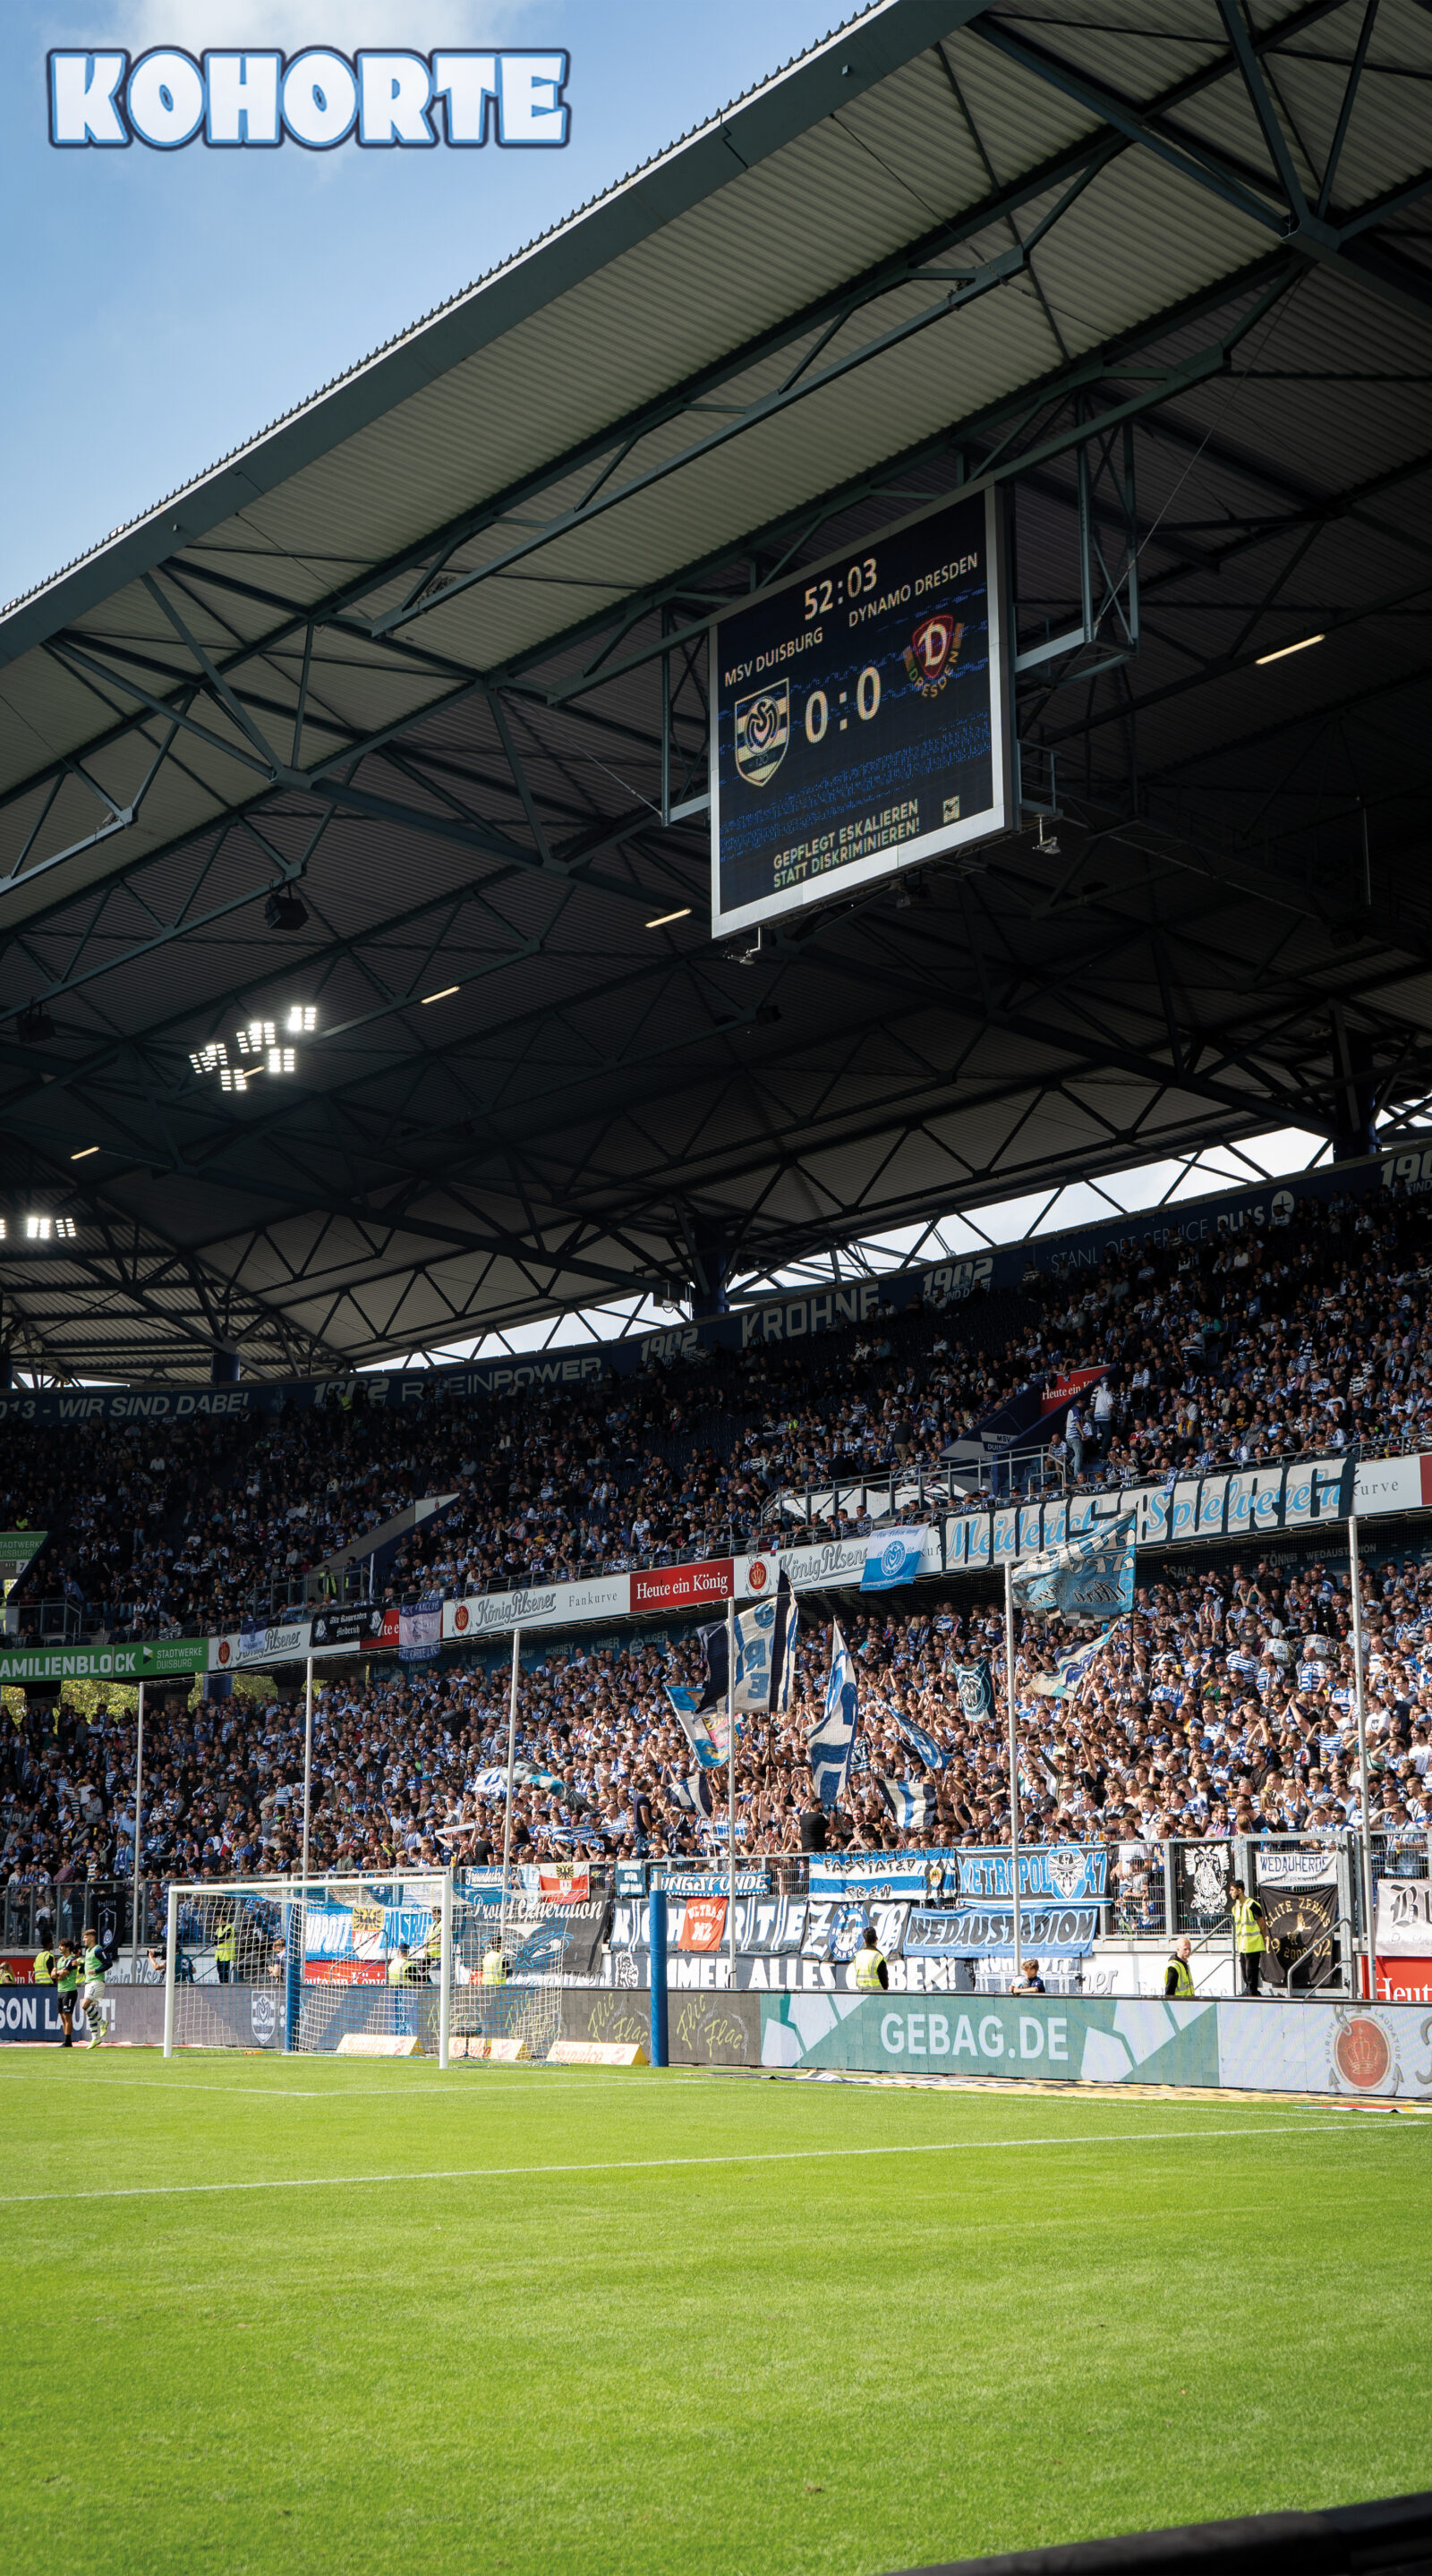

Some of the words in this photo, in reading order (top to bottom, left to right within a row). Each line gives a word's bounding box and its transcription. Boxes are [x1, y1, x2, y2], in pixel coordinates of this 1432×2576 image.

[805, 557, 877, 621] 52:03
[848, 584, 911, 627] DYNAMO
[915, 552, 978, 596] DRESDEN
[724, 660, 753, 687] MSV
[756, 626, 823, 673] DUISBURG
[773, 832, 834, 871] GEPFLEGT
[839, 798, 918, 845] ESKALIEREN
[773, 862, 807, 888] STATT
[811, 818, 920, 874] DISKRIMINIEREN!
[742, 1283, 879, 1348] KROHNE
[402, 1356, 602, 1402] REINPOWER
[1042, 1388, 1068, 1400] Heute
[58, 1398, 105, 1418] WIR
[109, 1396, 170, 1416] SIND
[946, 1501, 1103, 1559] Meiderich
[821, 1543, 868, 1575] Pilsen
[1305, 1543, 1377, 1561] WEDAUSTDION
[636, 1581, 670, 1600] Heute
[672, 1579, 690, 1594] ein
[692, 1572, 729, 1595] König
[475, 1596, 514, 1627] König
[511, 1590, 557, 1616] Pilsener
[568, 1590, 618, 1608] Fankurve
[157, 1646, 203, 1659] STADTWERKE
[264, 1628, 302, 1653] Pilsener
[156, 1658, 192, 1670] DUISBURG
[1085, 1850, 1107, 1894] 47
[1259, 1856, 1329, 1873] WEDAUHERDE
[686, 1904, 724, 1921] ULTRAS
[906, 1909, 1098, 1947] WEDAUSTADION
[1265, 1900, 1293, 1928] ELITE
[1299, 1897, 1331, 1928] ZEBRAS
[748, 1958, 837, 1990] ALLES
[846, 1957, 957, 1992] BEN!
[45, 1998, 116, 2031] LUT!
[587, 1993, 615, 2043] Flic
[676, 1994, 706, 2050] Flic
[704, 2019, 743, 2059] Flac
[880, 2011, 1070, 2061] GEBAG.DE
